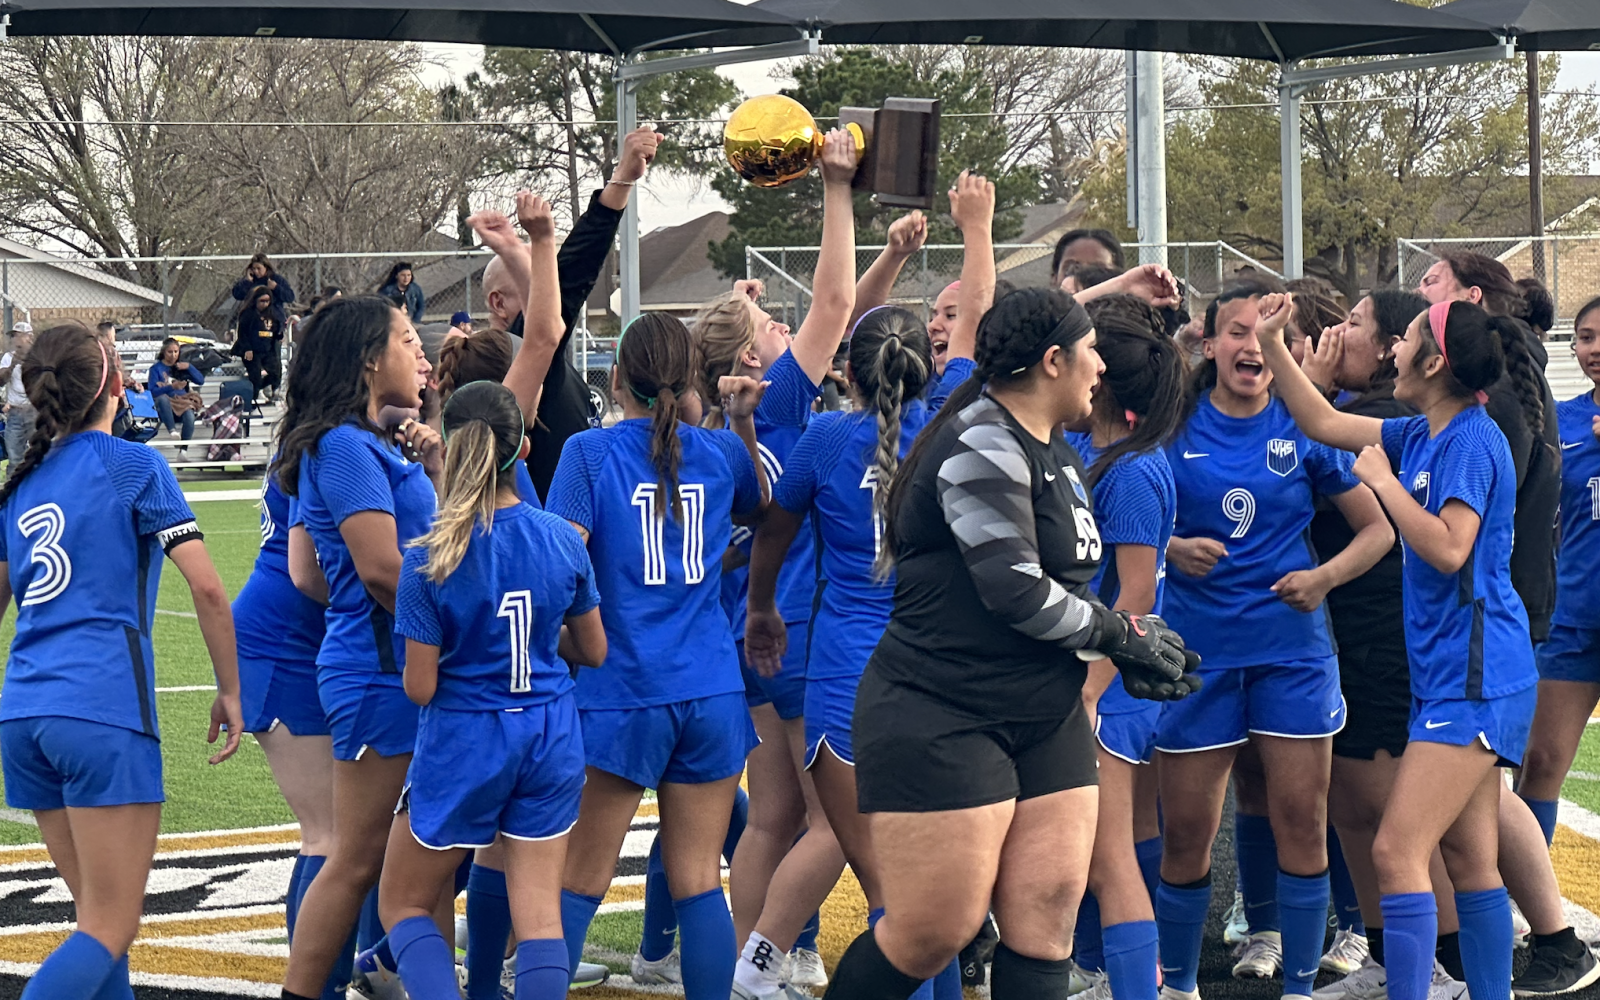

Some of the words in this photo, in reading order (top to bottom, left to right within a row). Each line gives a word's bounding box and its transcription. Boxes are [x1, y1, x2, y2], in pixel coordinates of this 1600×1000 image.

[1270, 440, 1293, 458] LVHS
[18, 503, 72, 606] 3
[631, 483, 705, 585] 11
[1222, 488, 1256, 538] 9
[497, 590, 533, 693] 1
